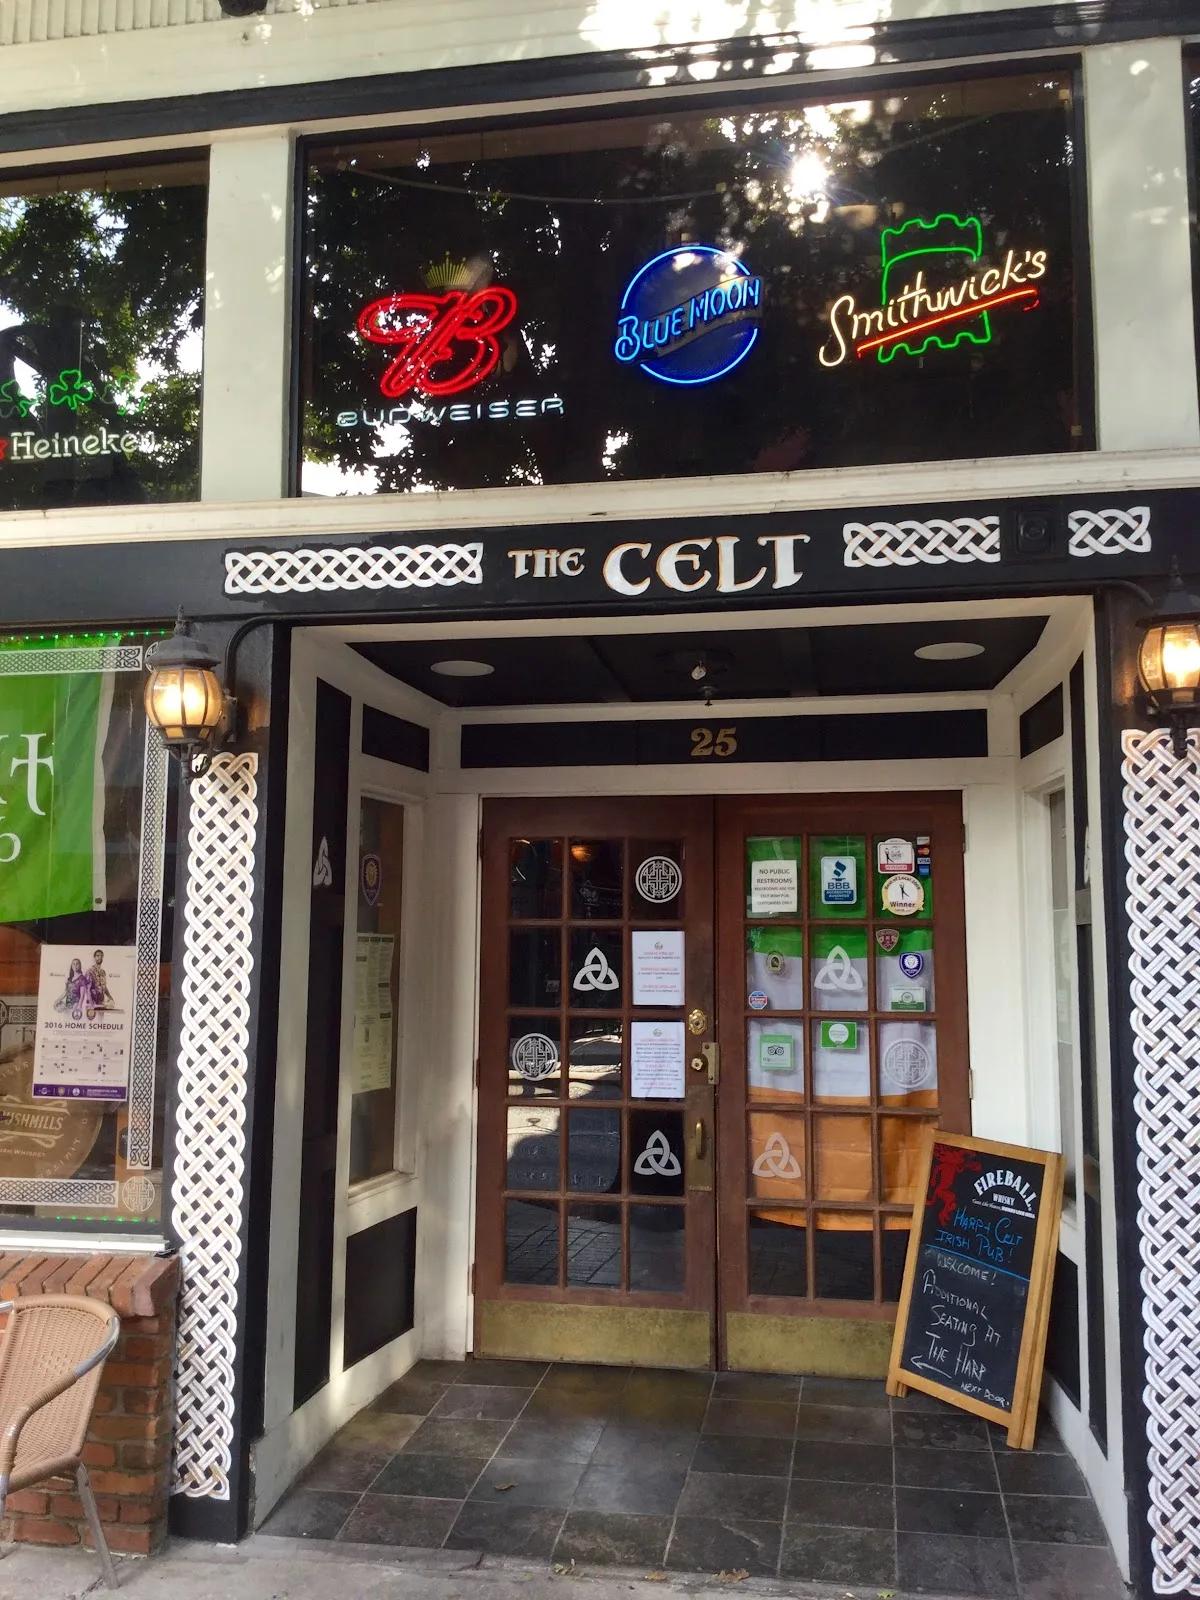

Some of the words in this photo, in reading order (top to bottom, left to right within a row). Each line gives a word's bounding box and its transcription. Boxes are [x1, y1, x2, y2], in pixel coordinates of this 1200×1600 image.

[614, 306, 684, 361] BLUE
[688, 278, 760, 328] MOON
[818, 249, 1046, 367] Smithwick's
[336, 397, 565, 427] BUDWEISER
[507, 548, 585, 579] THE
[603, 534, 811, 596] CELT
[690, 726, 738, 757] 25
[827, 882, 851, 890] BBB
[88, 1023, 124, 1031] SCHEDULE
[973, 1169, 1037, 1212] FIREBALL
[993, 1193, 1015, 1206] WHISKY
[954, 1205, 984, 1232] HARP
[936, 1229, 970, 1249] IRISH
[923, 1269, 987, 1320] ADDITIONAL
[984, 1324, 1001, 1347] AT
[926, 1331, 949, 1362] THE
[955, 1345, 986, 1382] HARP
[961, 1381, 981, 1393] NEXT
